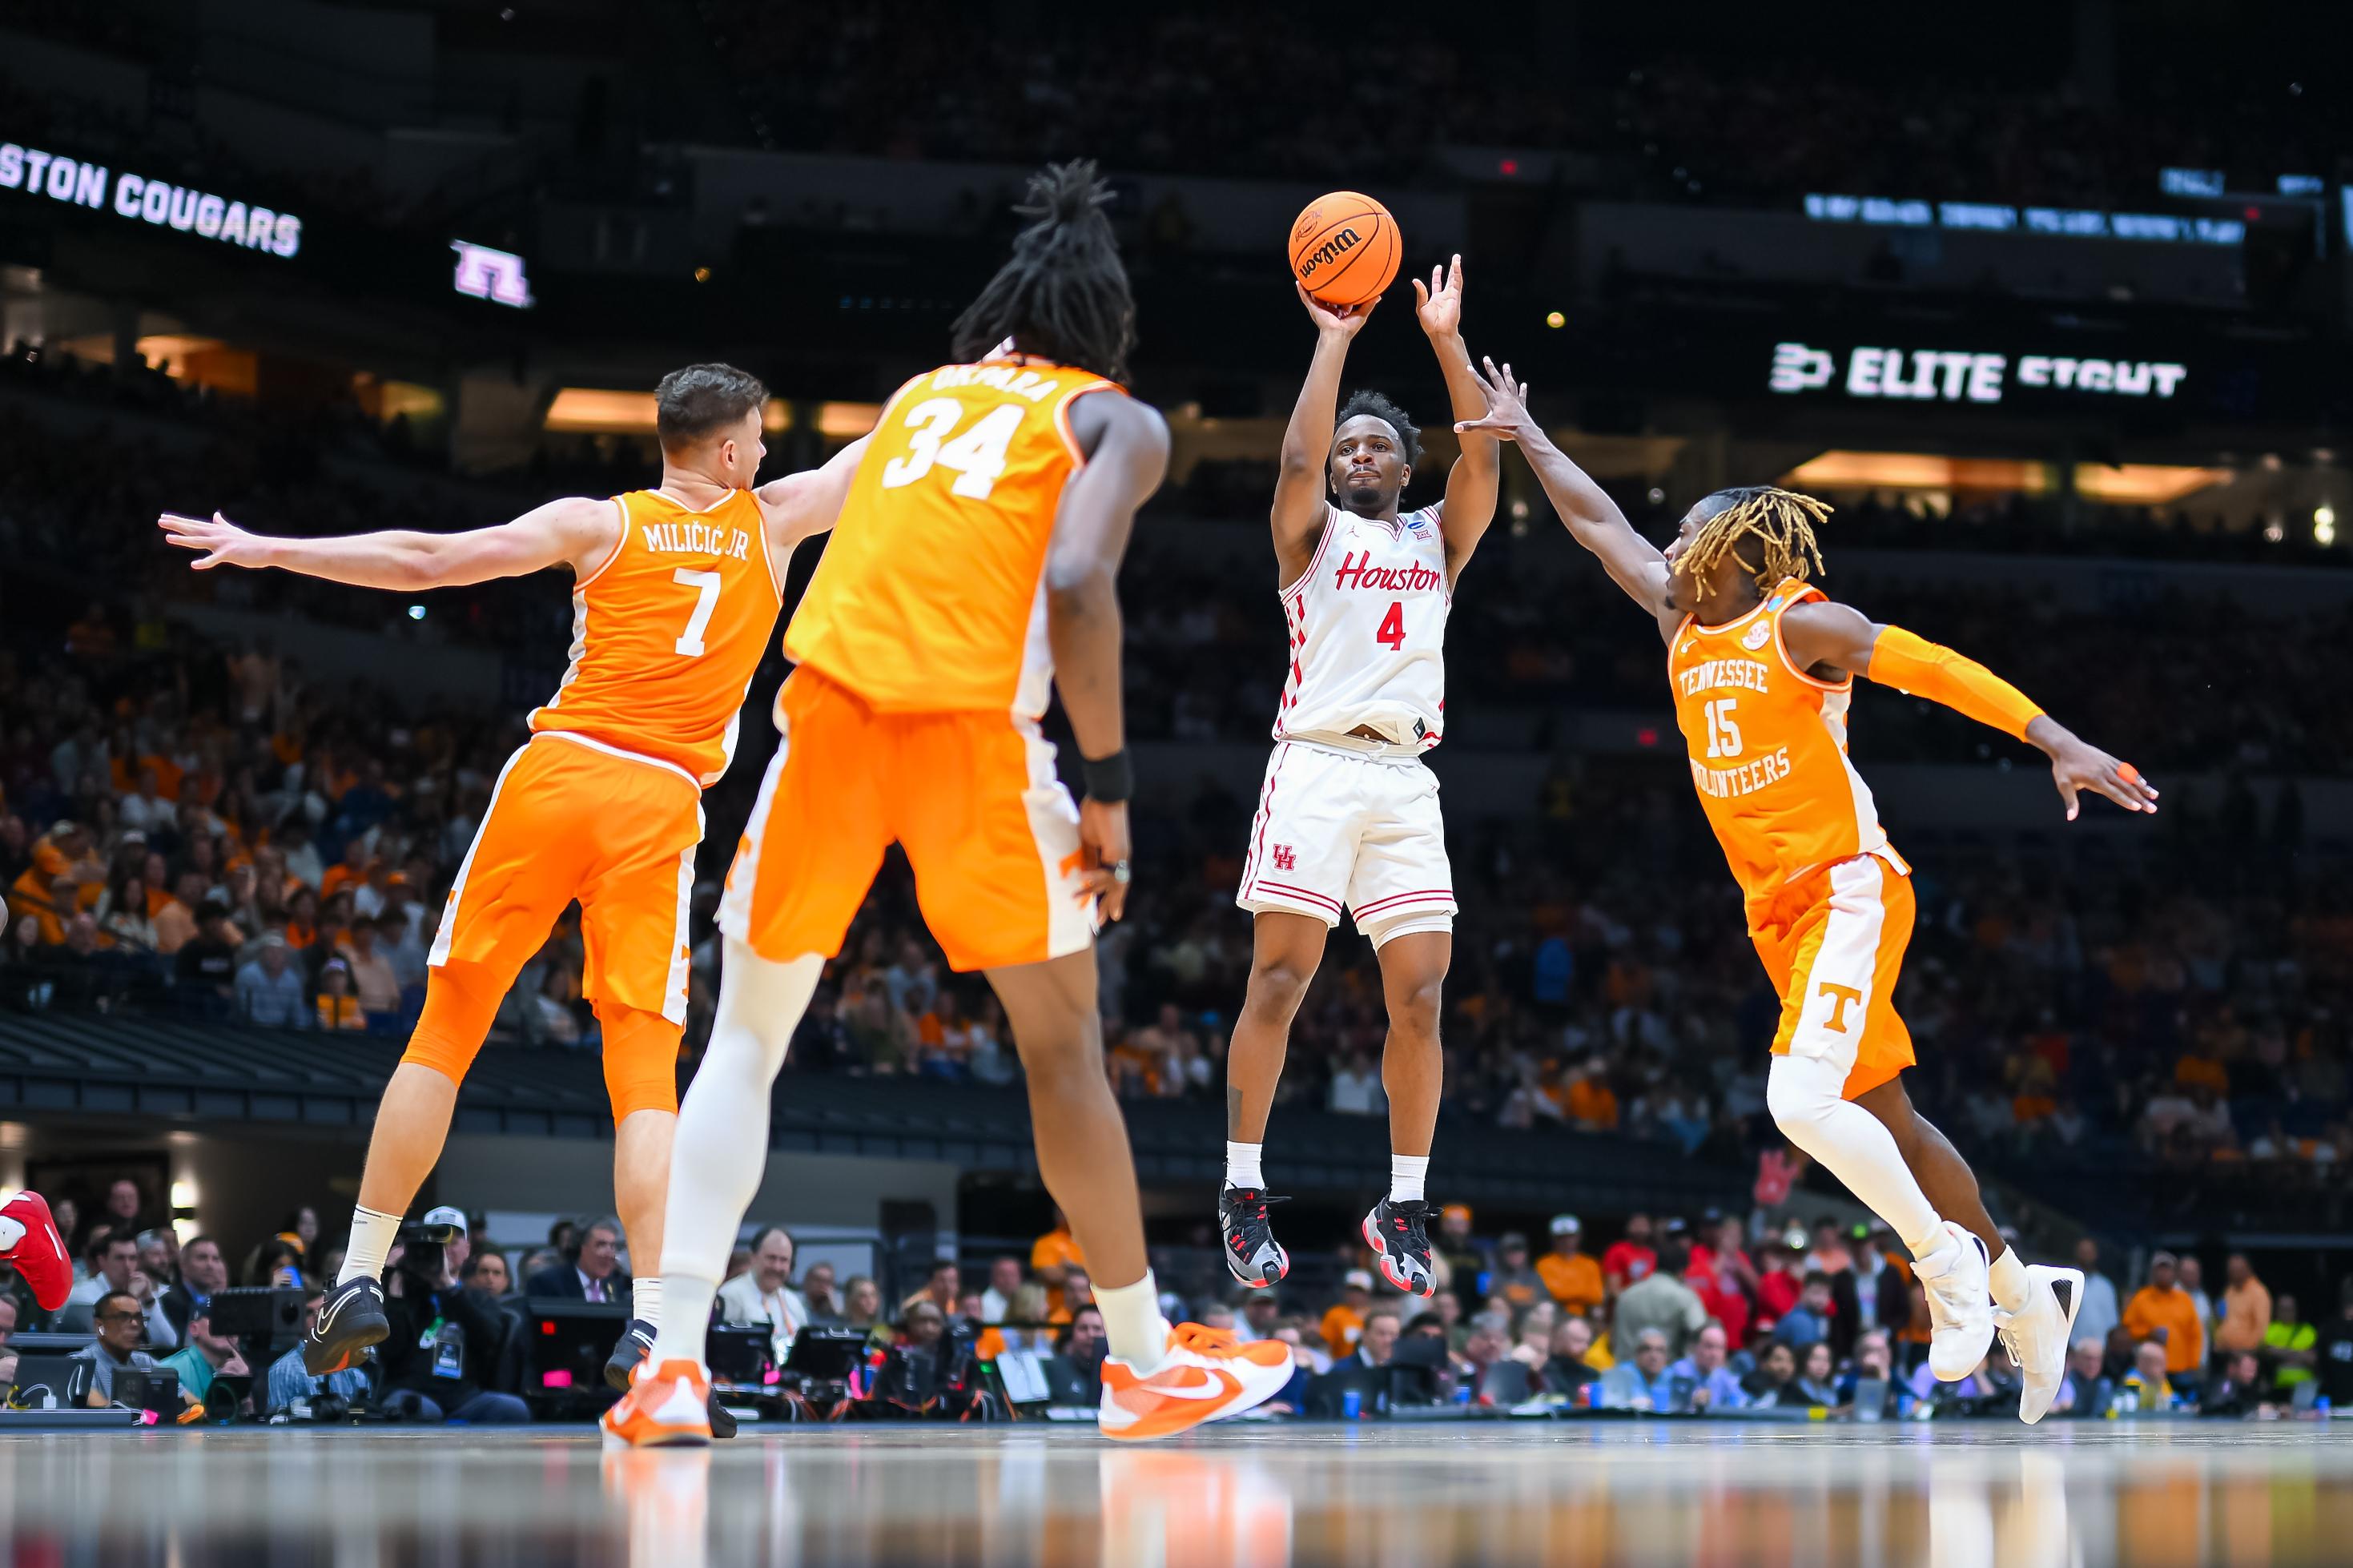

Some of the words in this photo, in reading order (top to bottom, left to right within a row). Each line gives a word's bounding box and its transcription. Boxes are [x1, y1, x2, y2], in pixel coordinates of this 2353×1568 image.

[115, 171, 301, 258] COUGARS
[1298, 228, 1362, 279] Wilson
[1846, 346, 2007, 403] ELITE
[882, 397, 1025, 501] 34
[1334, 549, 1441, 591] Houston
[672, 567, 721, 657] 7
[1376, 601, 1406, 651] 4
[1679, 659, 1768, 698] TENNESSEE
[1704, 698, 1743, 758] 15
[1819, 982, 1862, 1034] T
